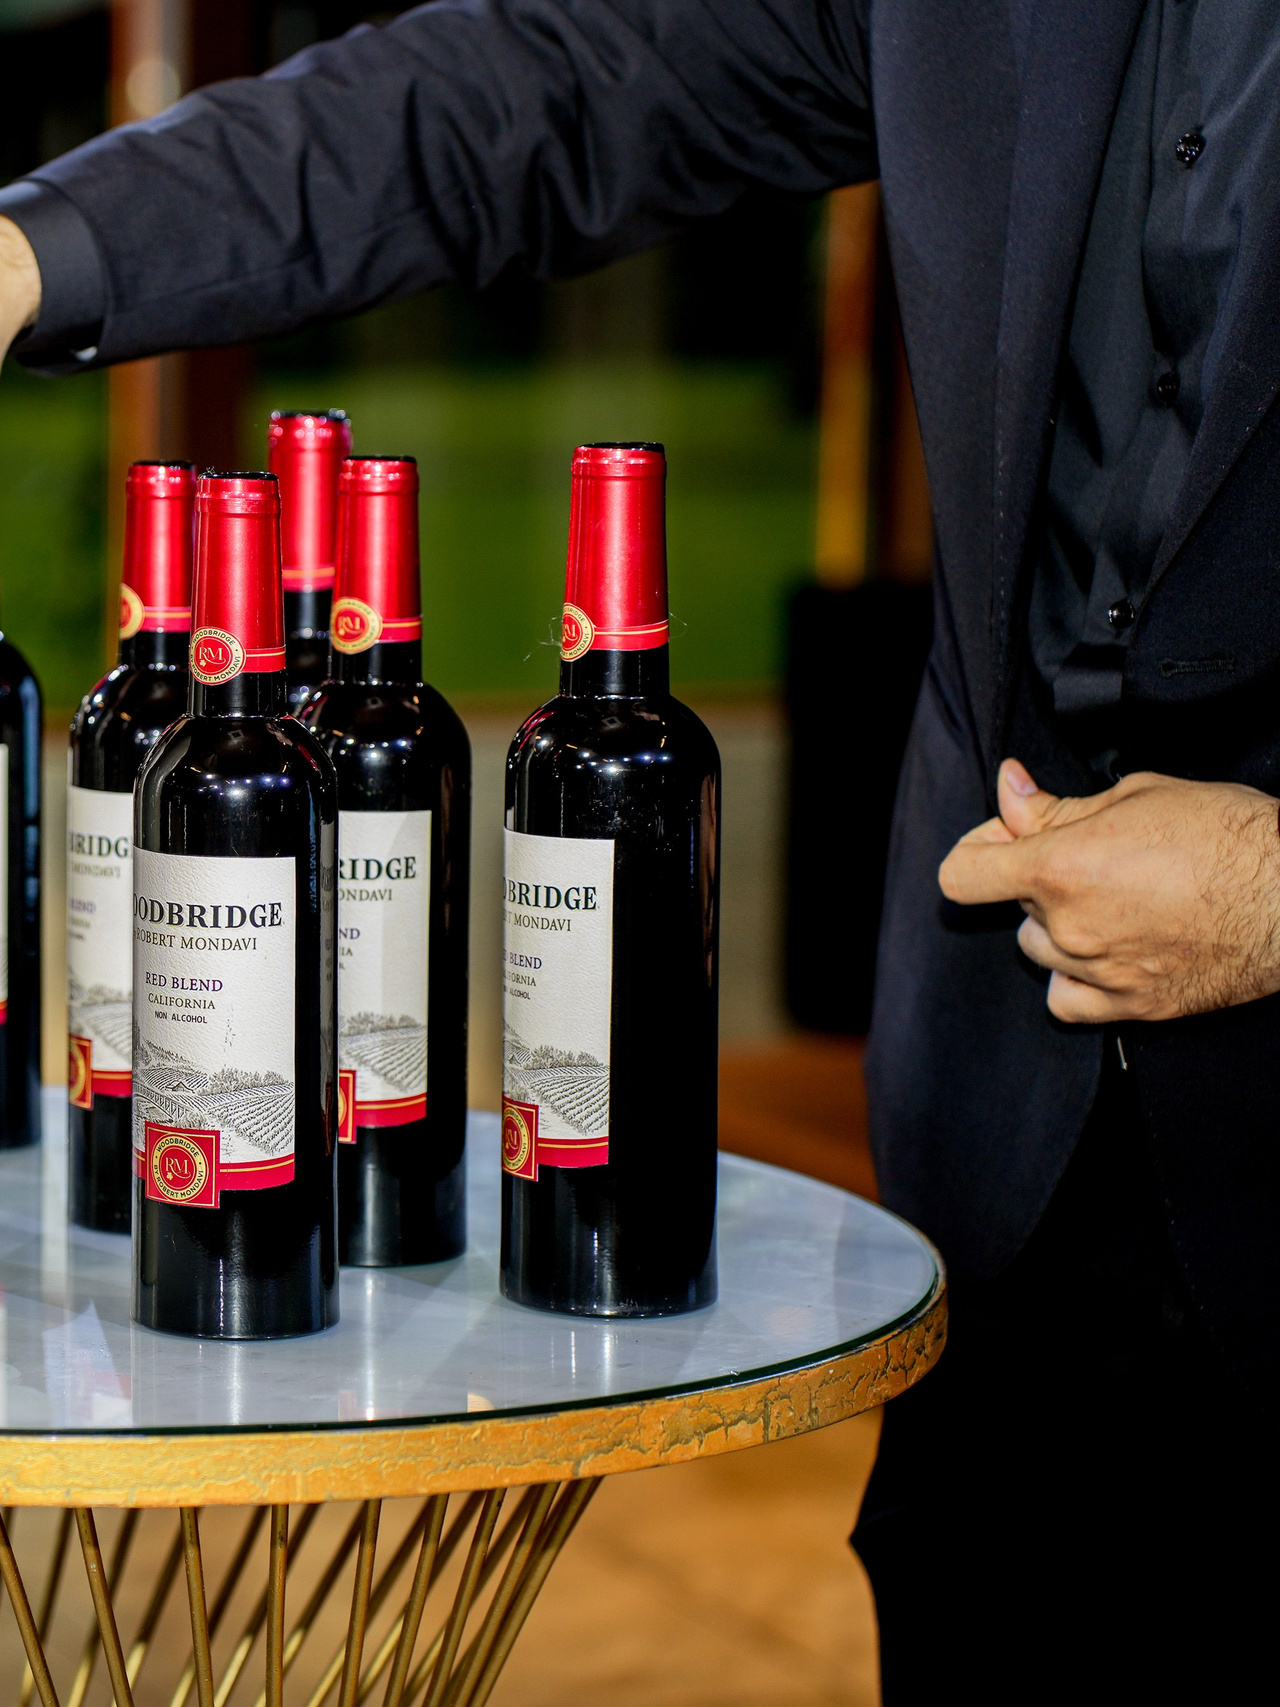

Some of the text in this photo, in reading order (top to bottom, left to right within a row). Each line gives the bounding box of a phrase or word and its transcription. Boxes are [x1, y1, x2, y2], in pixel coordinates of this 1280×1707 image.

[192, 629, 235, 646] WOODBRIDGE
[199, 647, 226, 664] RM
[214, 656, 241, 682] MONDAVI
[133, 893, 282, 928] OODBRIDGE
[514, 913, 571, 931] MONDAVI
[137, 927, 175, 948] ROBERT
[181, 936, 257, 951] MONDAVI
[510, 952, 542, 969] BLEND
[145, 972, 223, 992] RED BLEND
[148, 993, 216, 1010] CALIFORNIA
[155, 1011, 208, 1024] NON ALCOHOL
[156, 1137, 200, 1158] WOODBRIDGE
[165, 1157, 192, 1179] RM
[154, 1165, 204, 1198] BY ROBERT MONDAVI
